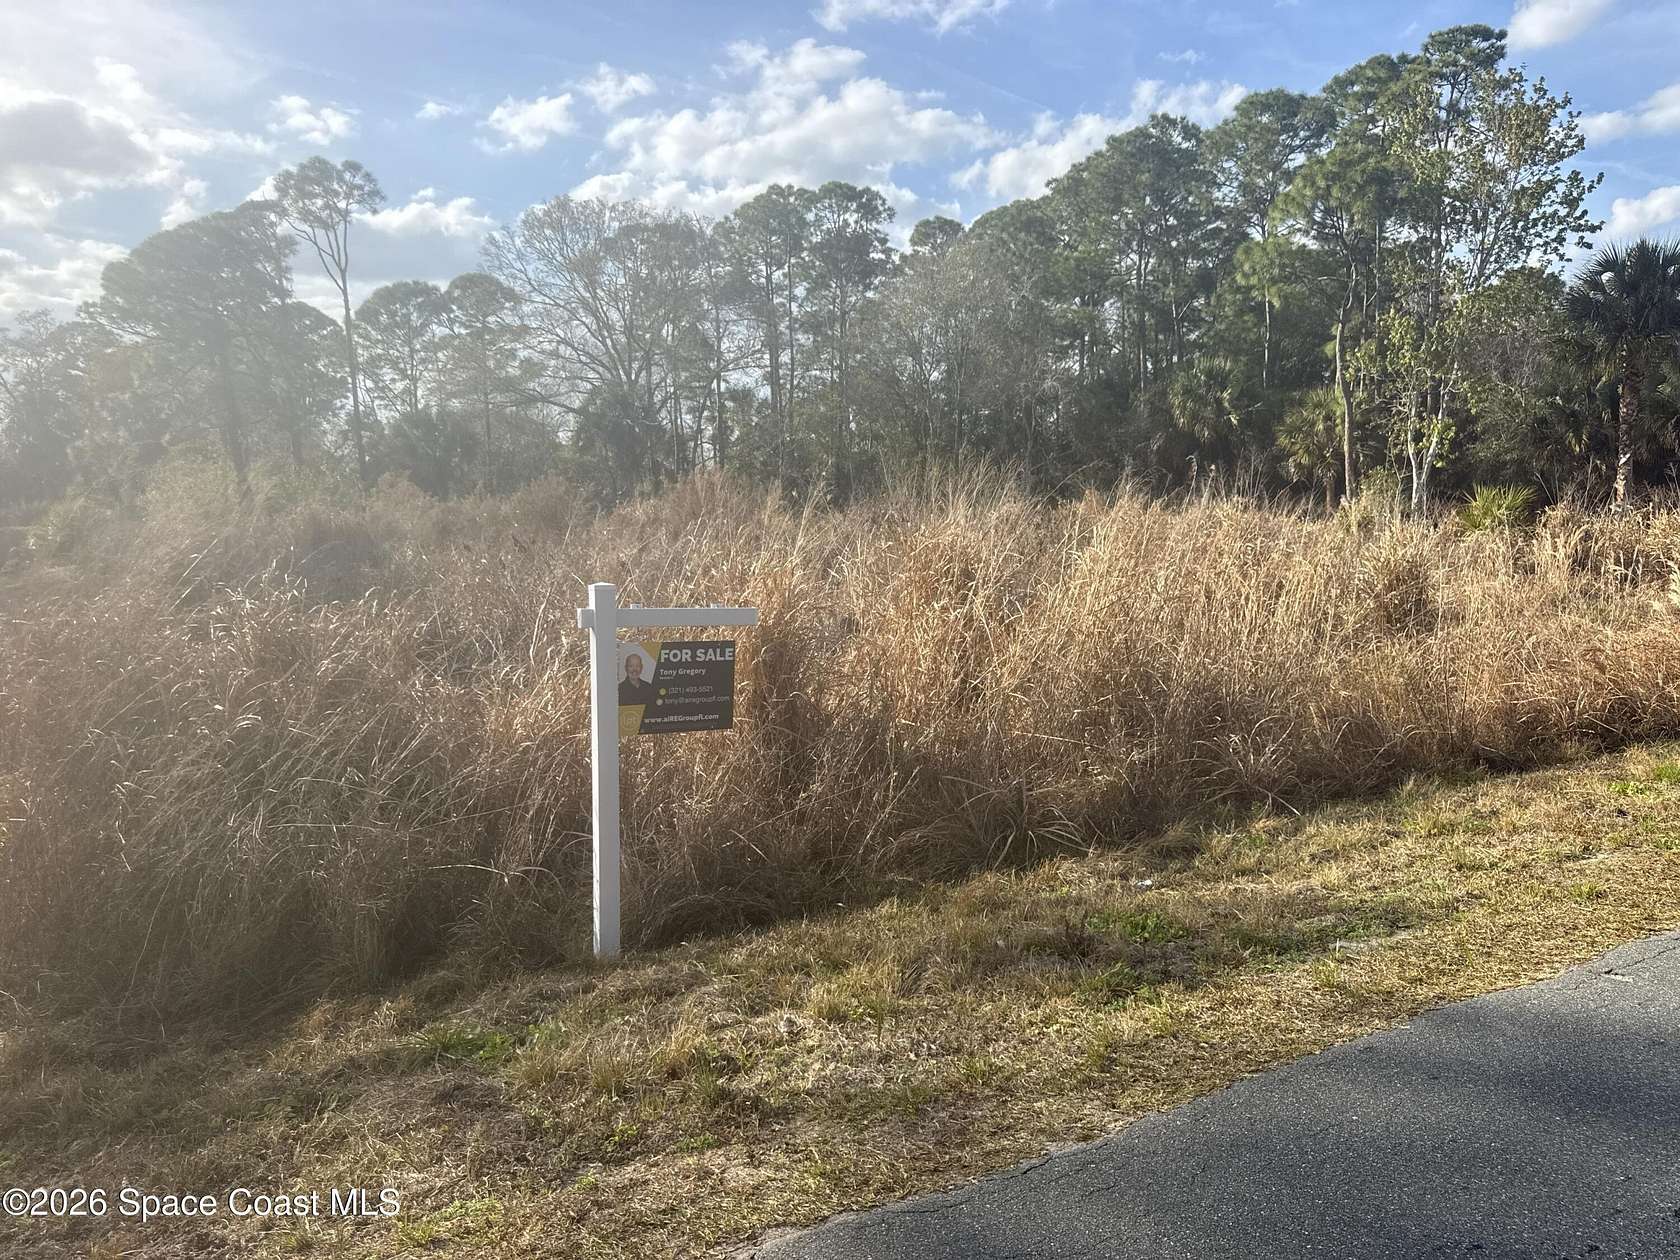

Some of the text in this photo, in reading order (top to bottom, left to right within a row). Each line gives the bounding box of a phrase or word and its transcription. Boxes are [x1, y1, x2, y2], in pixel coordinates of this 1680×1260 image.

[660, 648, 734, 662] FOR SALE
[659, 668, 706, 677] Tony Gregory
